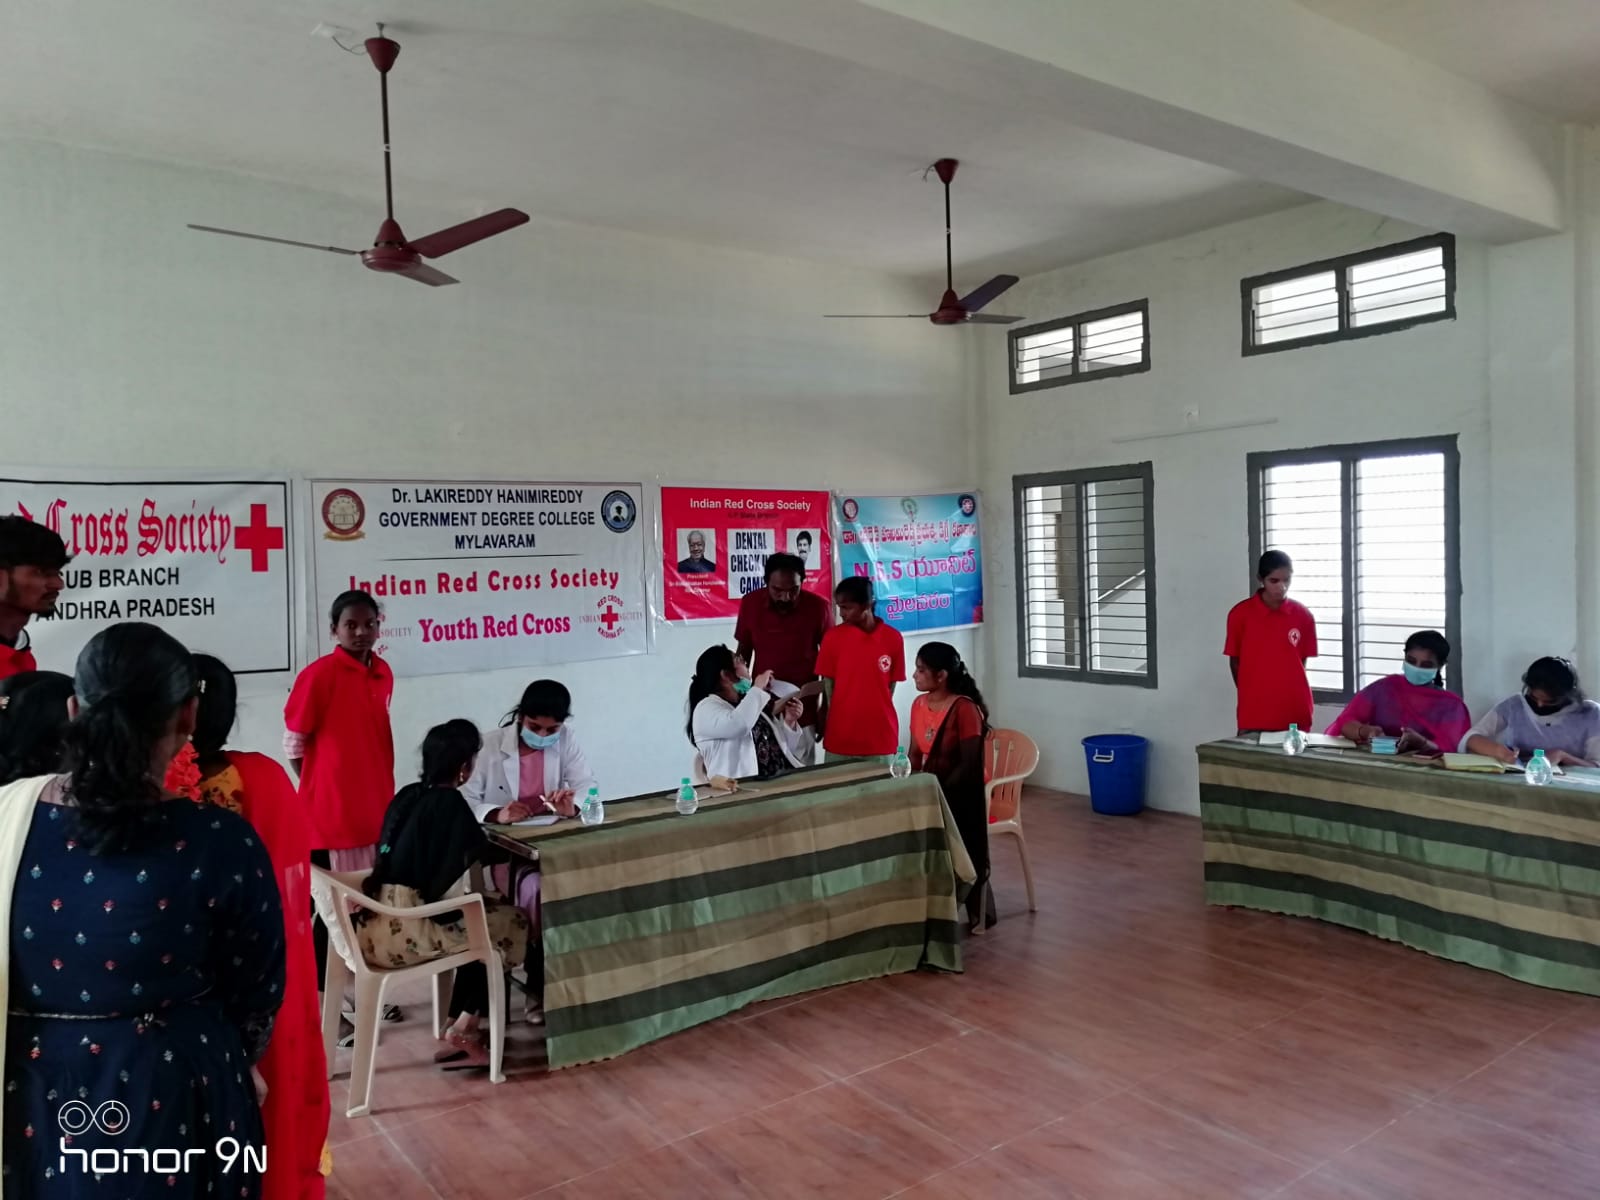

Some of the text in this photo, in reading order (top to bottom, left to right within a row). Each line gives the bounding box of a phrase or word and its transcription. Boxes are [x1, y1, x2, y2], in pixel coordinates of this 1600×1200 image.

[392, 488, 583, 504] Dr. LAKIREDDY HANIMIREDDY
[690, 498, 812, 512] Indian Red Cross Society
[379, 511, 595, 527] GOVERNMENT DEGREE COLLEGE
[137, 498, 231, 564] Society
[735, 531, 767, 550] DENTAL
[455, 534, 535, 550] MYLAVARAM
[730, 554, 761, 573] CHECK
[58, 567, 180, 589] UB BRANCH
[350, 568, 619, 596] Indian Red Cross Society
[36, 597, 215, 622] NDHRA PRADESH
[418, 612, 571, 643] Youth Red Cross
